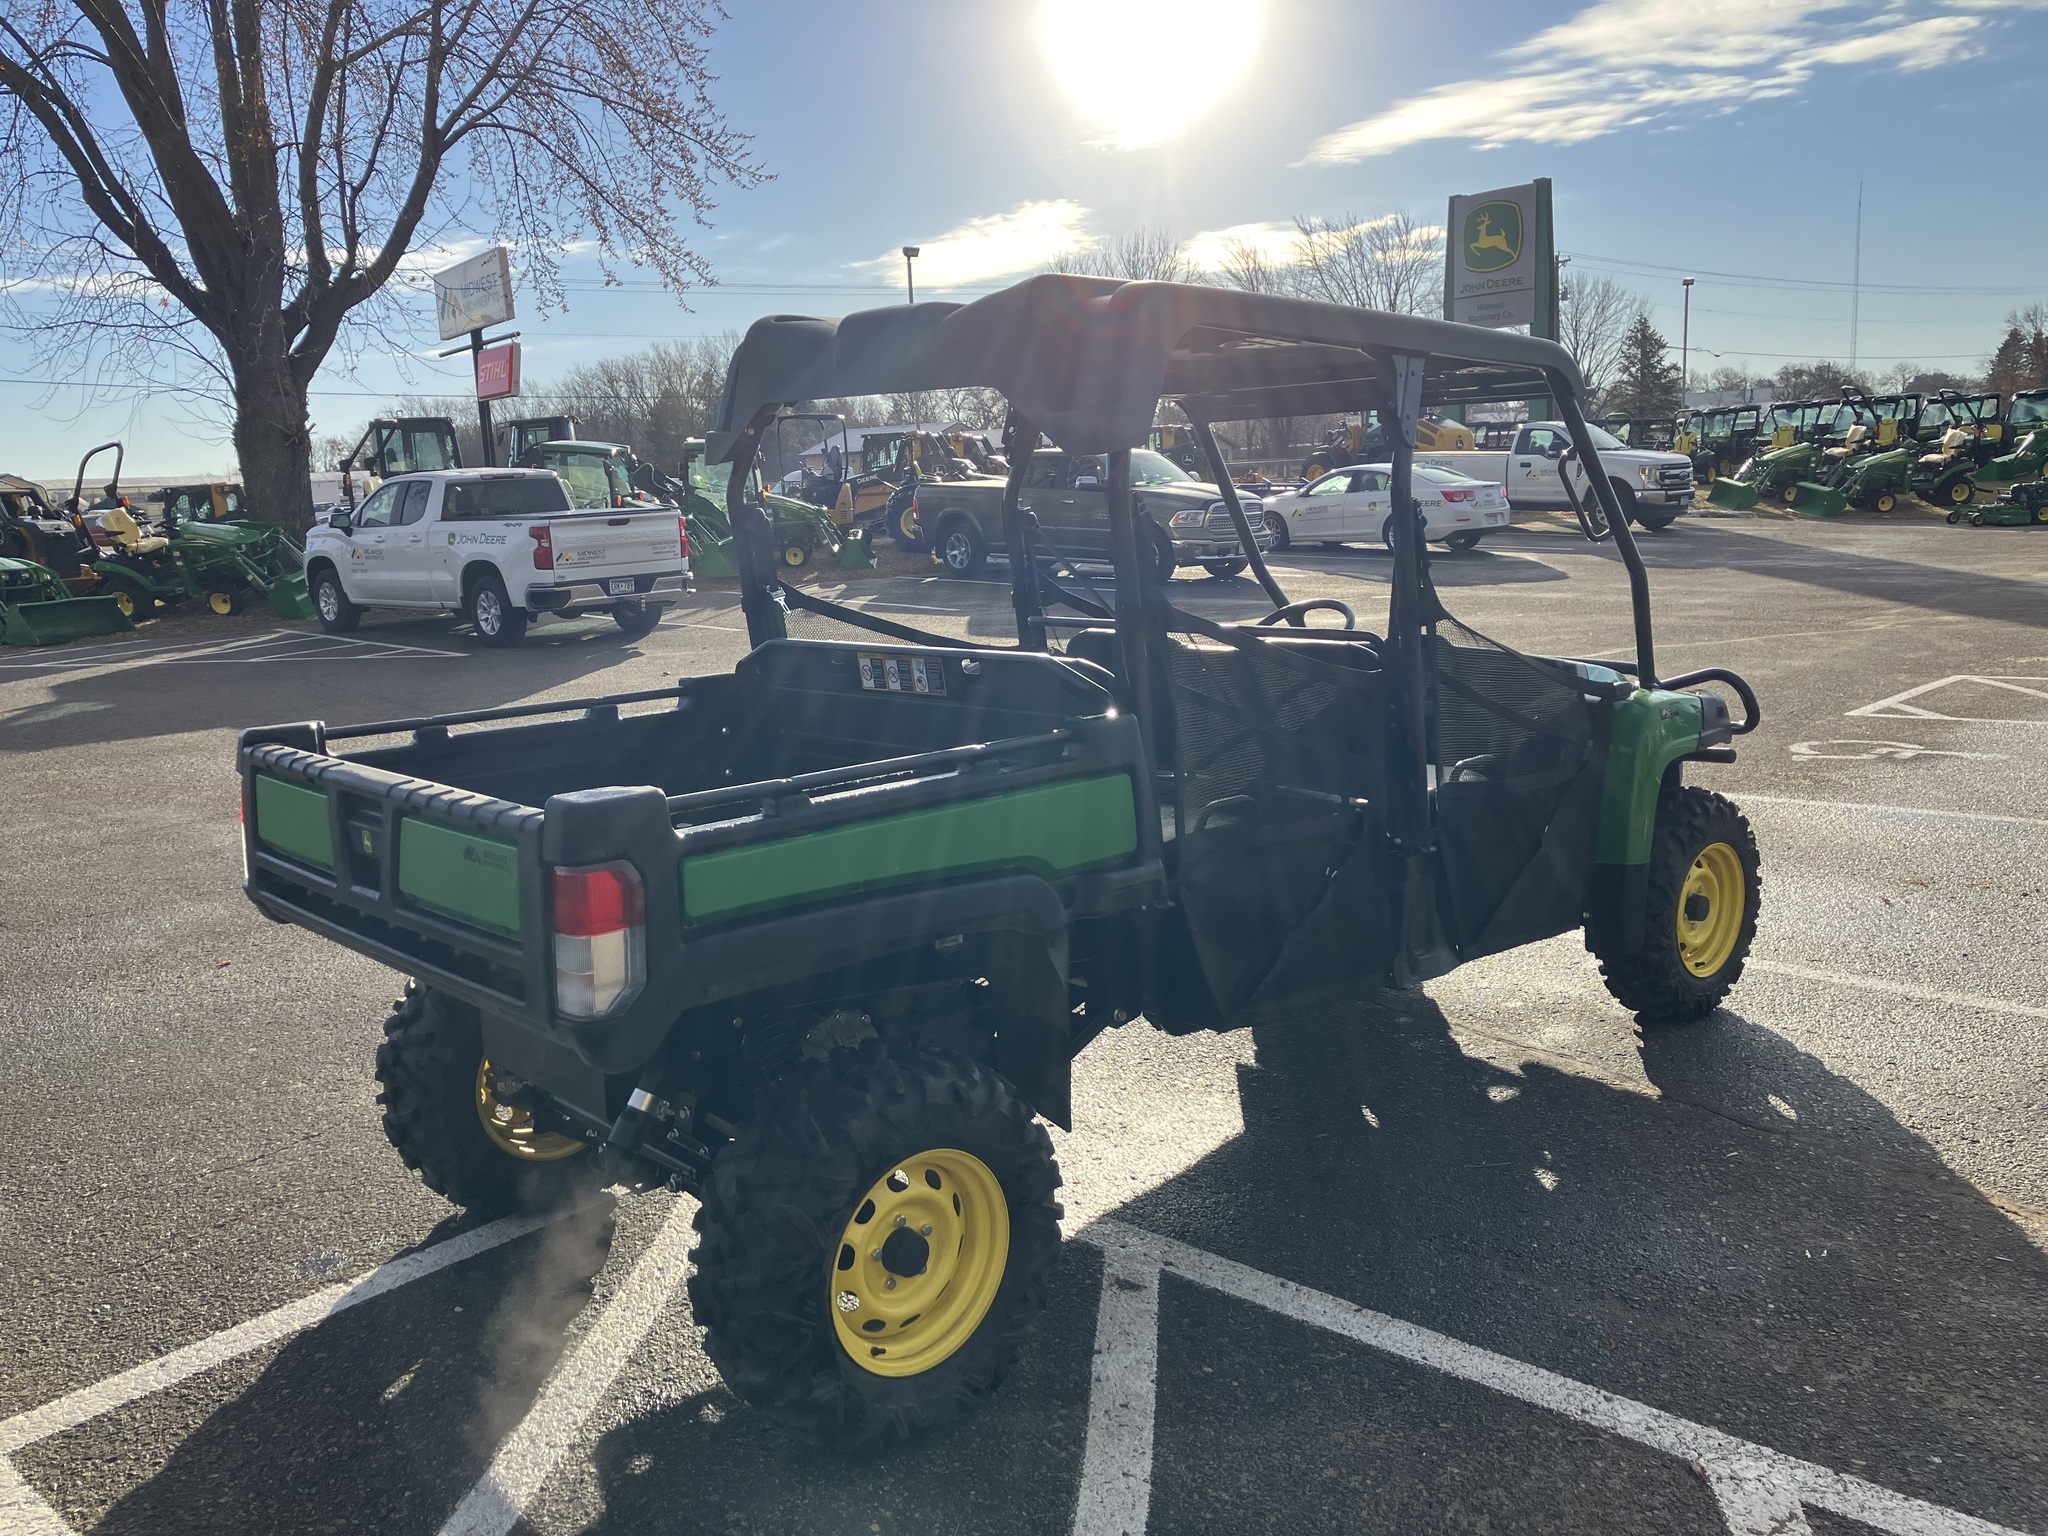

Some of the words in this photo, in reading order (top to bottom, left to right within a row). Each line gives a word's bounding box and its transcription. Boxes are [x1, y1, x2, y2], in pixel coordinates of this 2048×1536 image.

[461, 272, 498, 300] MIDWEST
[1460, 281, 1486, 294] JOHN
[1486, 276, 1524, 289] DEERE
[1477, 301, 1504, 312] Midwest
[1468, 311, 1500, 323] Machinery
[479, 360, 507, 384] STIHL
[857, 474, 878, 484] DEERE
[457, 532, 479, 545] JOHN
[479, 532, 507, 545] DEERE
[562, 530, 674, 545] CHEVROLET
[577, 549, 606, 557] MIDWEST
